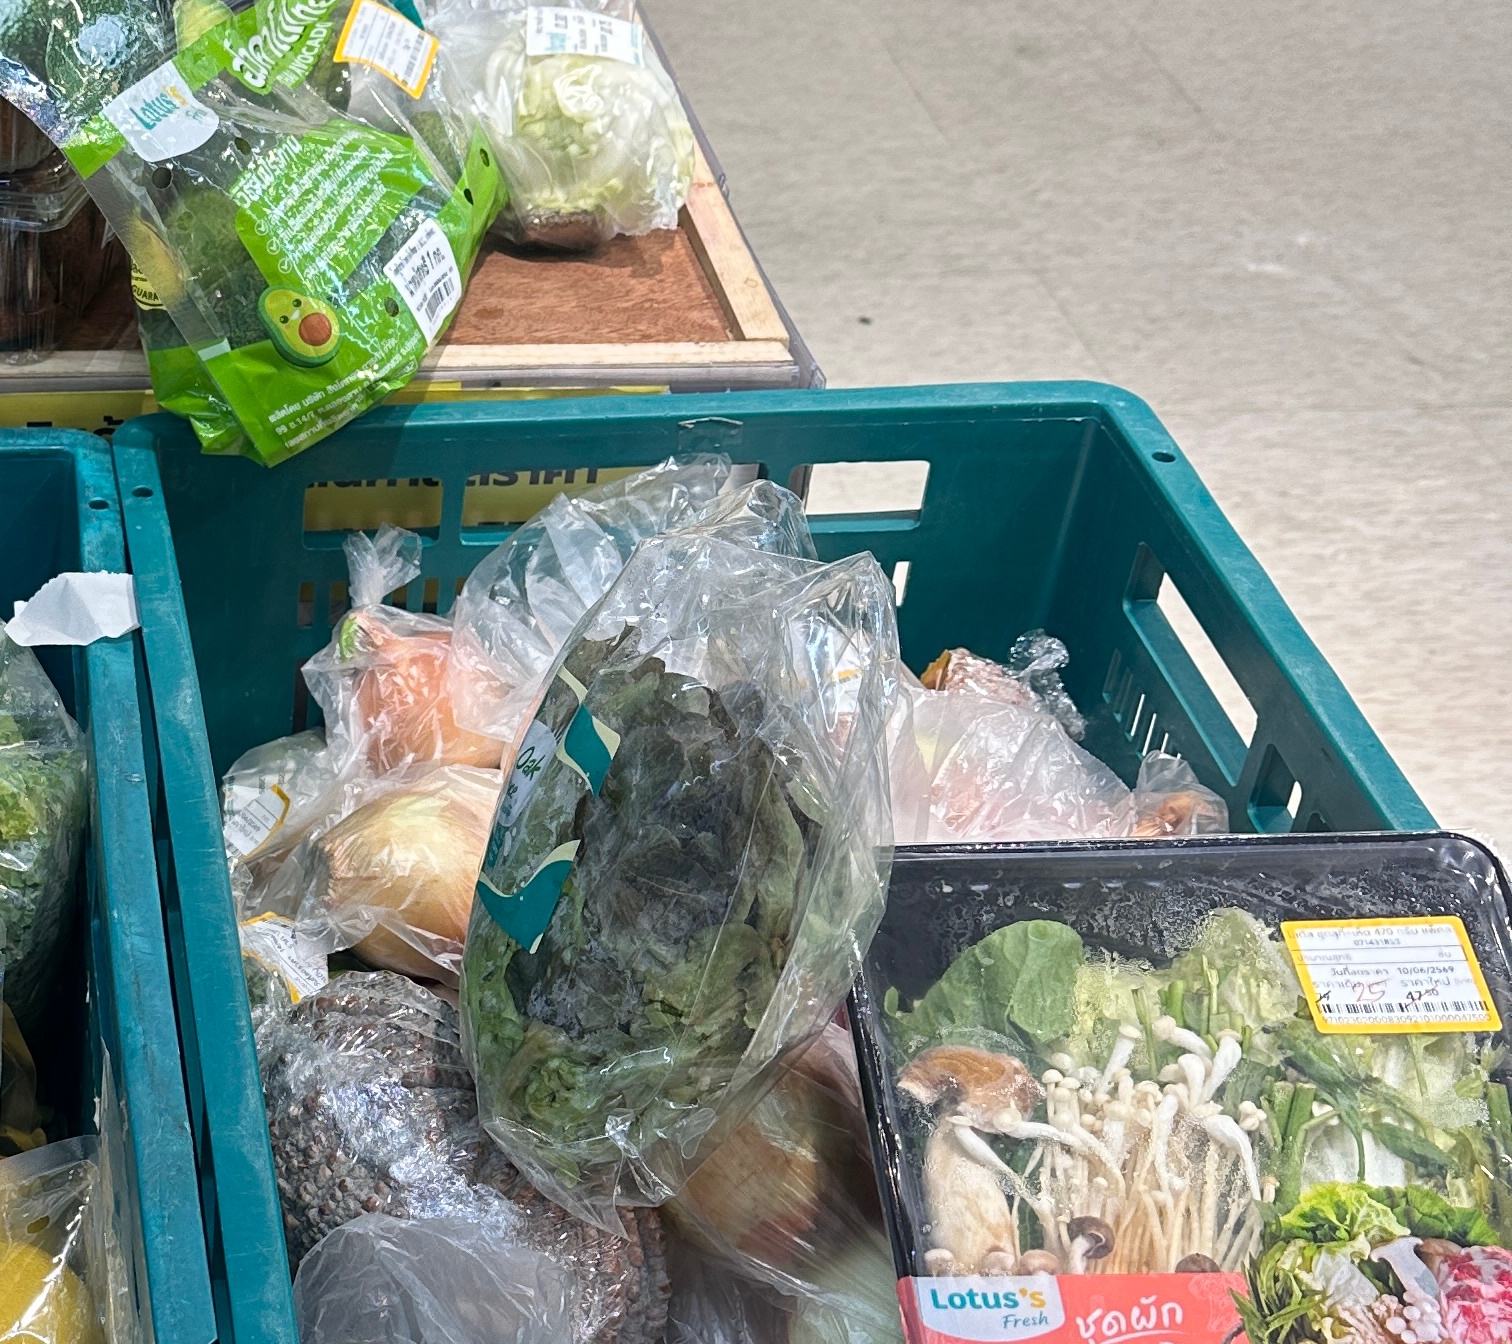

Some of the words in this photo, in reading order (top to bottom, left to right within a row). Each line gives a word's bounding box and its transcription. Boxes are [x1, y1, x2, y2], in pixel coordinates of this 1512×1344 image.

[516, 746, 546, 781] Oak
[1375, 928, 1393, 936] 470
[1397, 965, 1454, 975] 10/06/2569
[930, 1287, 1046, 1310] Lotus's
[1002, 1311, 1049, 1329] Fresh
